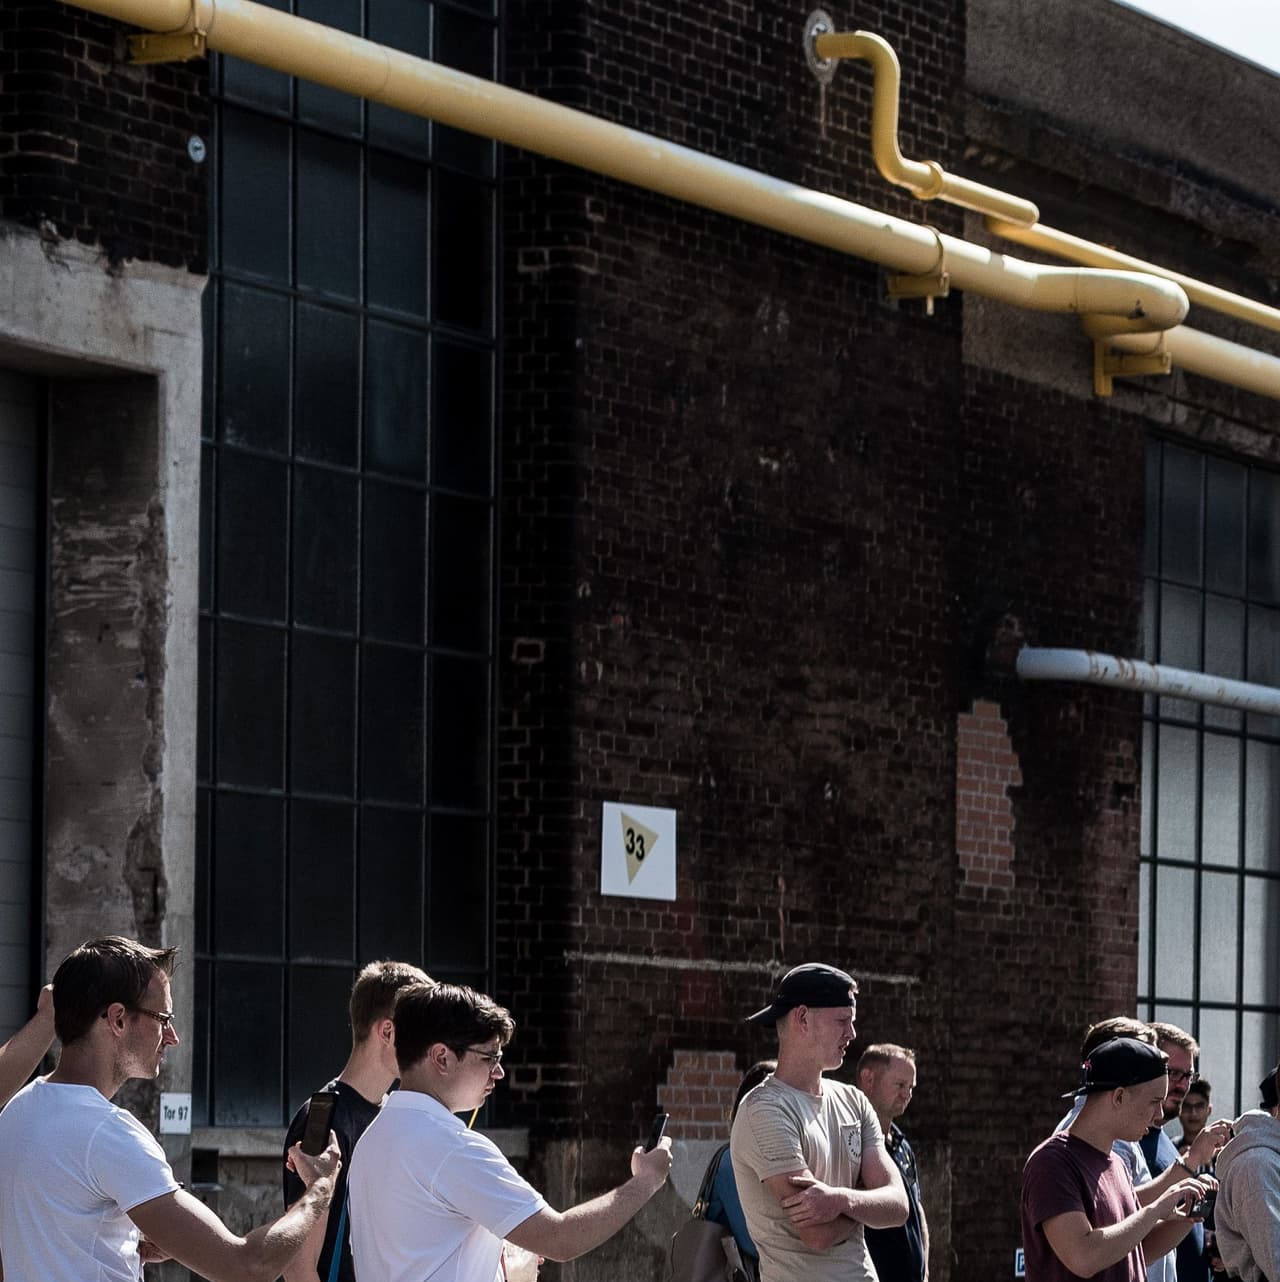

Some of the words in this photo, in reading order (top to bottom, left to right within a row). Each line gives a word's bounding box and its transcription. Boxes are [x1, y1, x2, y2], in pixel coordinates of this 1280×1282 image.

[625, 827, 646, 862] 33
[163, 1105, 176, 1121] Tor
[178, 1105, 189, 1121] 97
